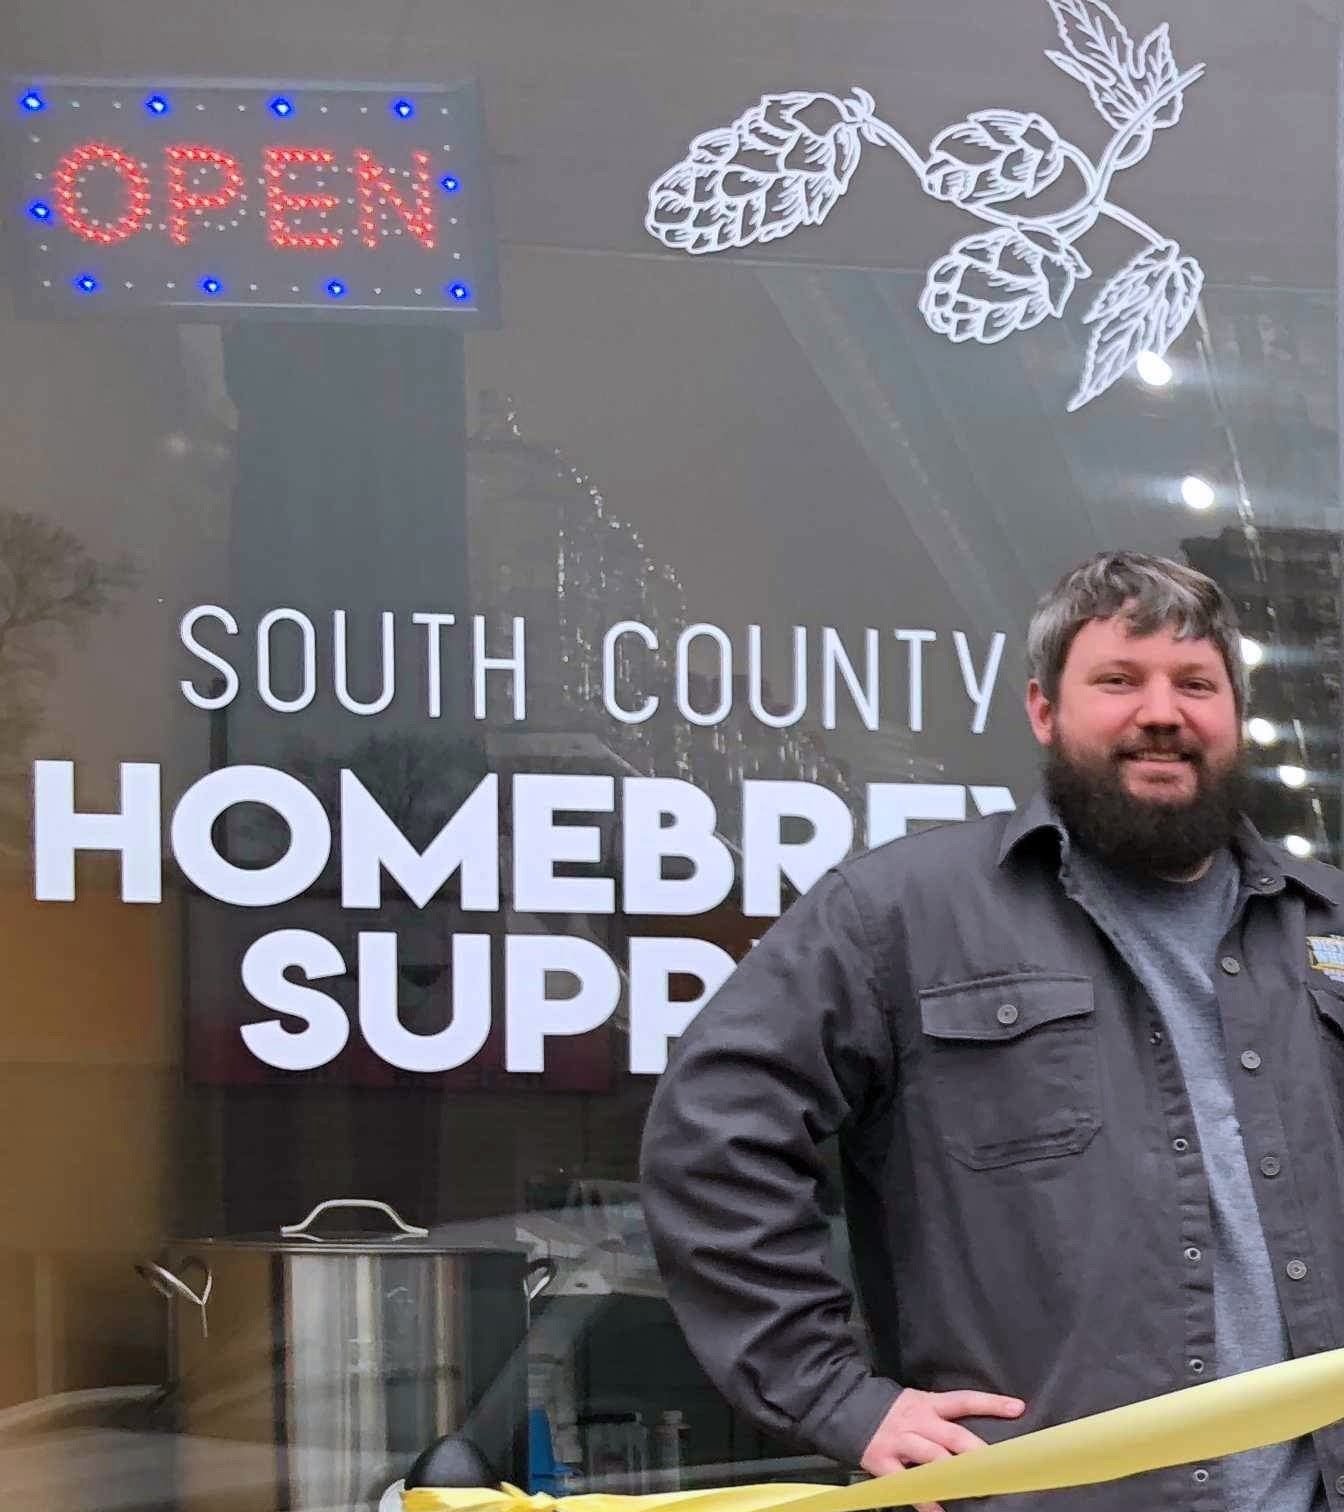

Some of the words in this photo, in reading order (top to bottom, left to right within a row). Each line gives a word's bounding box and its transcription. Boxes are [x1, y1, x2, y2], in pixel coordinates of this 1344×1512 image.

[54, 143, 438, 249] OPEN
[180, 604, 527, 720] SOUTH
[602, 620, 1006, 735] COUNTY
[34, 759, 1017, 917] HOMEBRE
[240, 928, 739, 1074] SUPP
